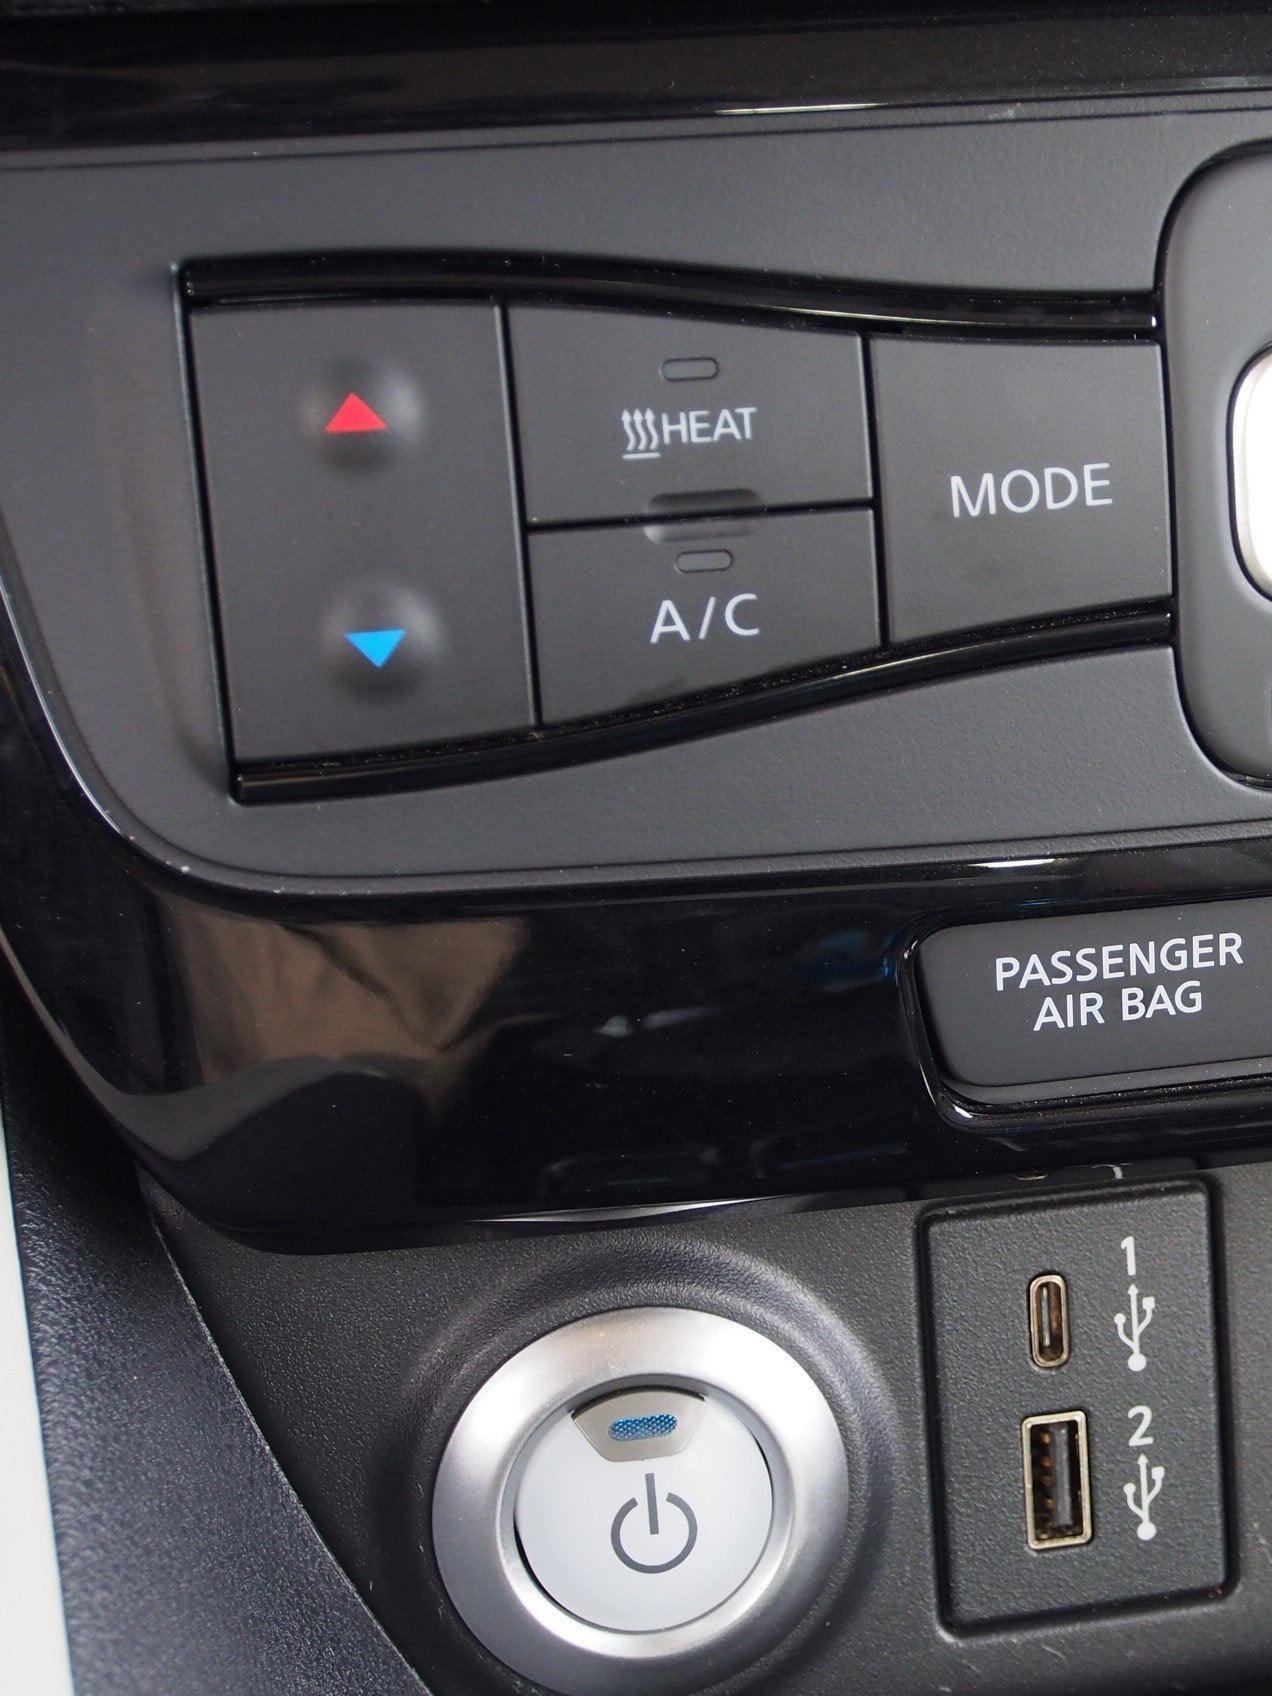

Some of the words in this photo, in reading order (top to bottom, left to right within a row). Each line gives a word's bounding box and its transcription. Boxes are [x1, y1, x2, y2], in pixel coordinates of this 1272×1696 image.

[661, 407, 758, 445] HEAT
[950, 462, 1113, 518] MODE
[650, 593, 760, 644] A/C
[995, 932, 1244, 991] PASSENGER
[1033, 992, 1105, 1031] AIR
[1121, 980, 1202, 1021] BAG
[1120, 1235, 1136, 1275] 1
[1127, 1405, 1154, 1447] 2
